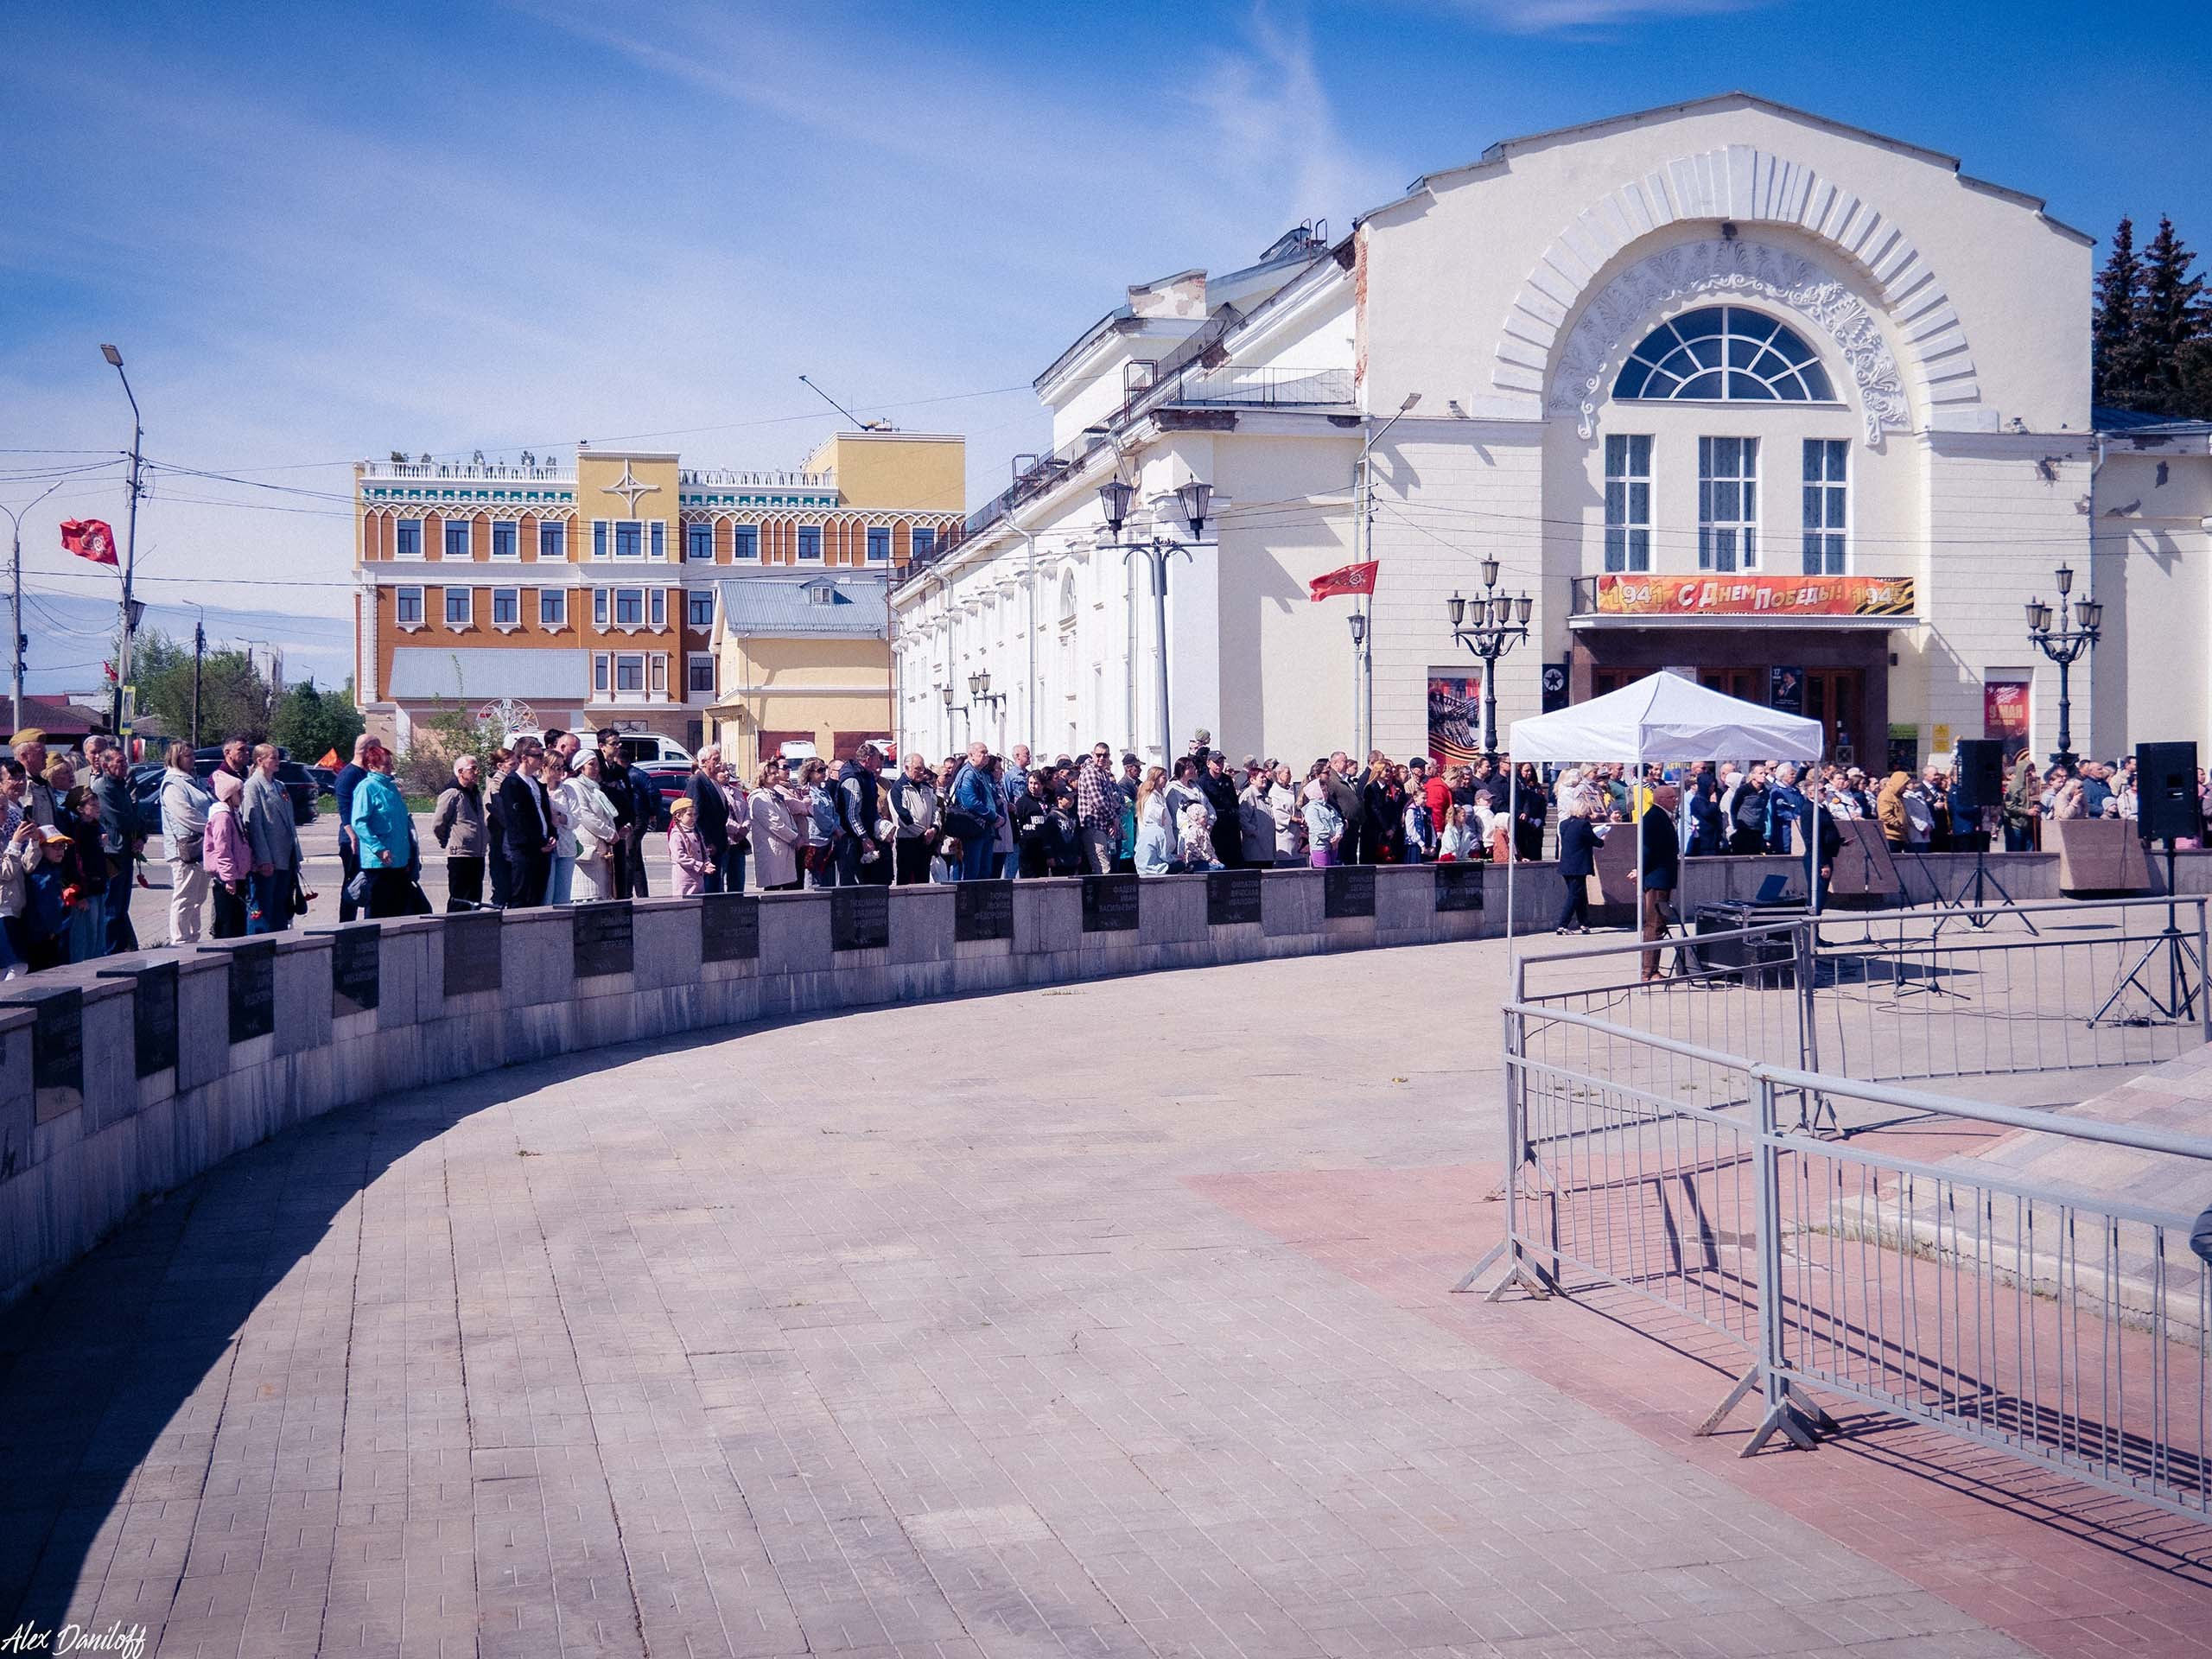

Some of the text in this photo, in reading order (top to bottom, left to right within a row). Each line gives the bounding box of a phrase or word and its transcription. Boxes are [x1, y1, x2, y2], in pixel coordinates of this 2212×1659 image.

[1607, 585, 1663, 604] 1941
[1678, 583, 1696, 607] С
[1852, 587, 1906, 605] 1945
[1988, 704, 2023, 718] 9 МАЯ
